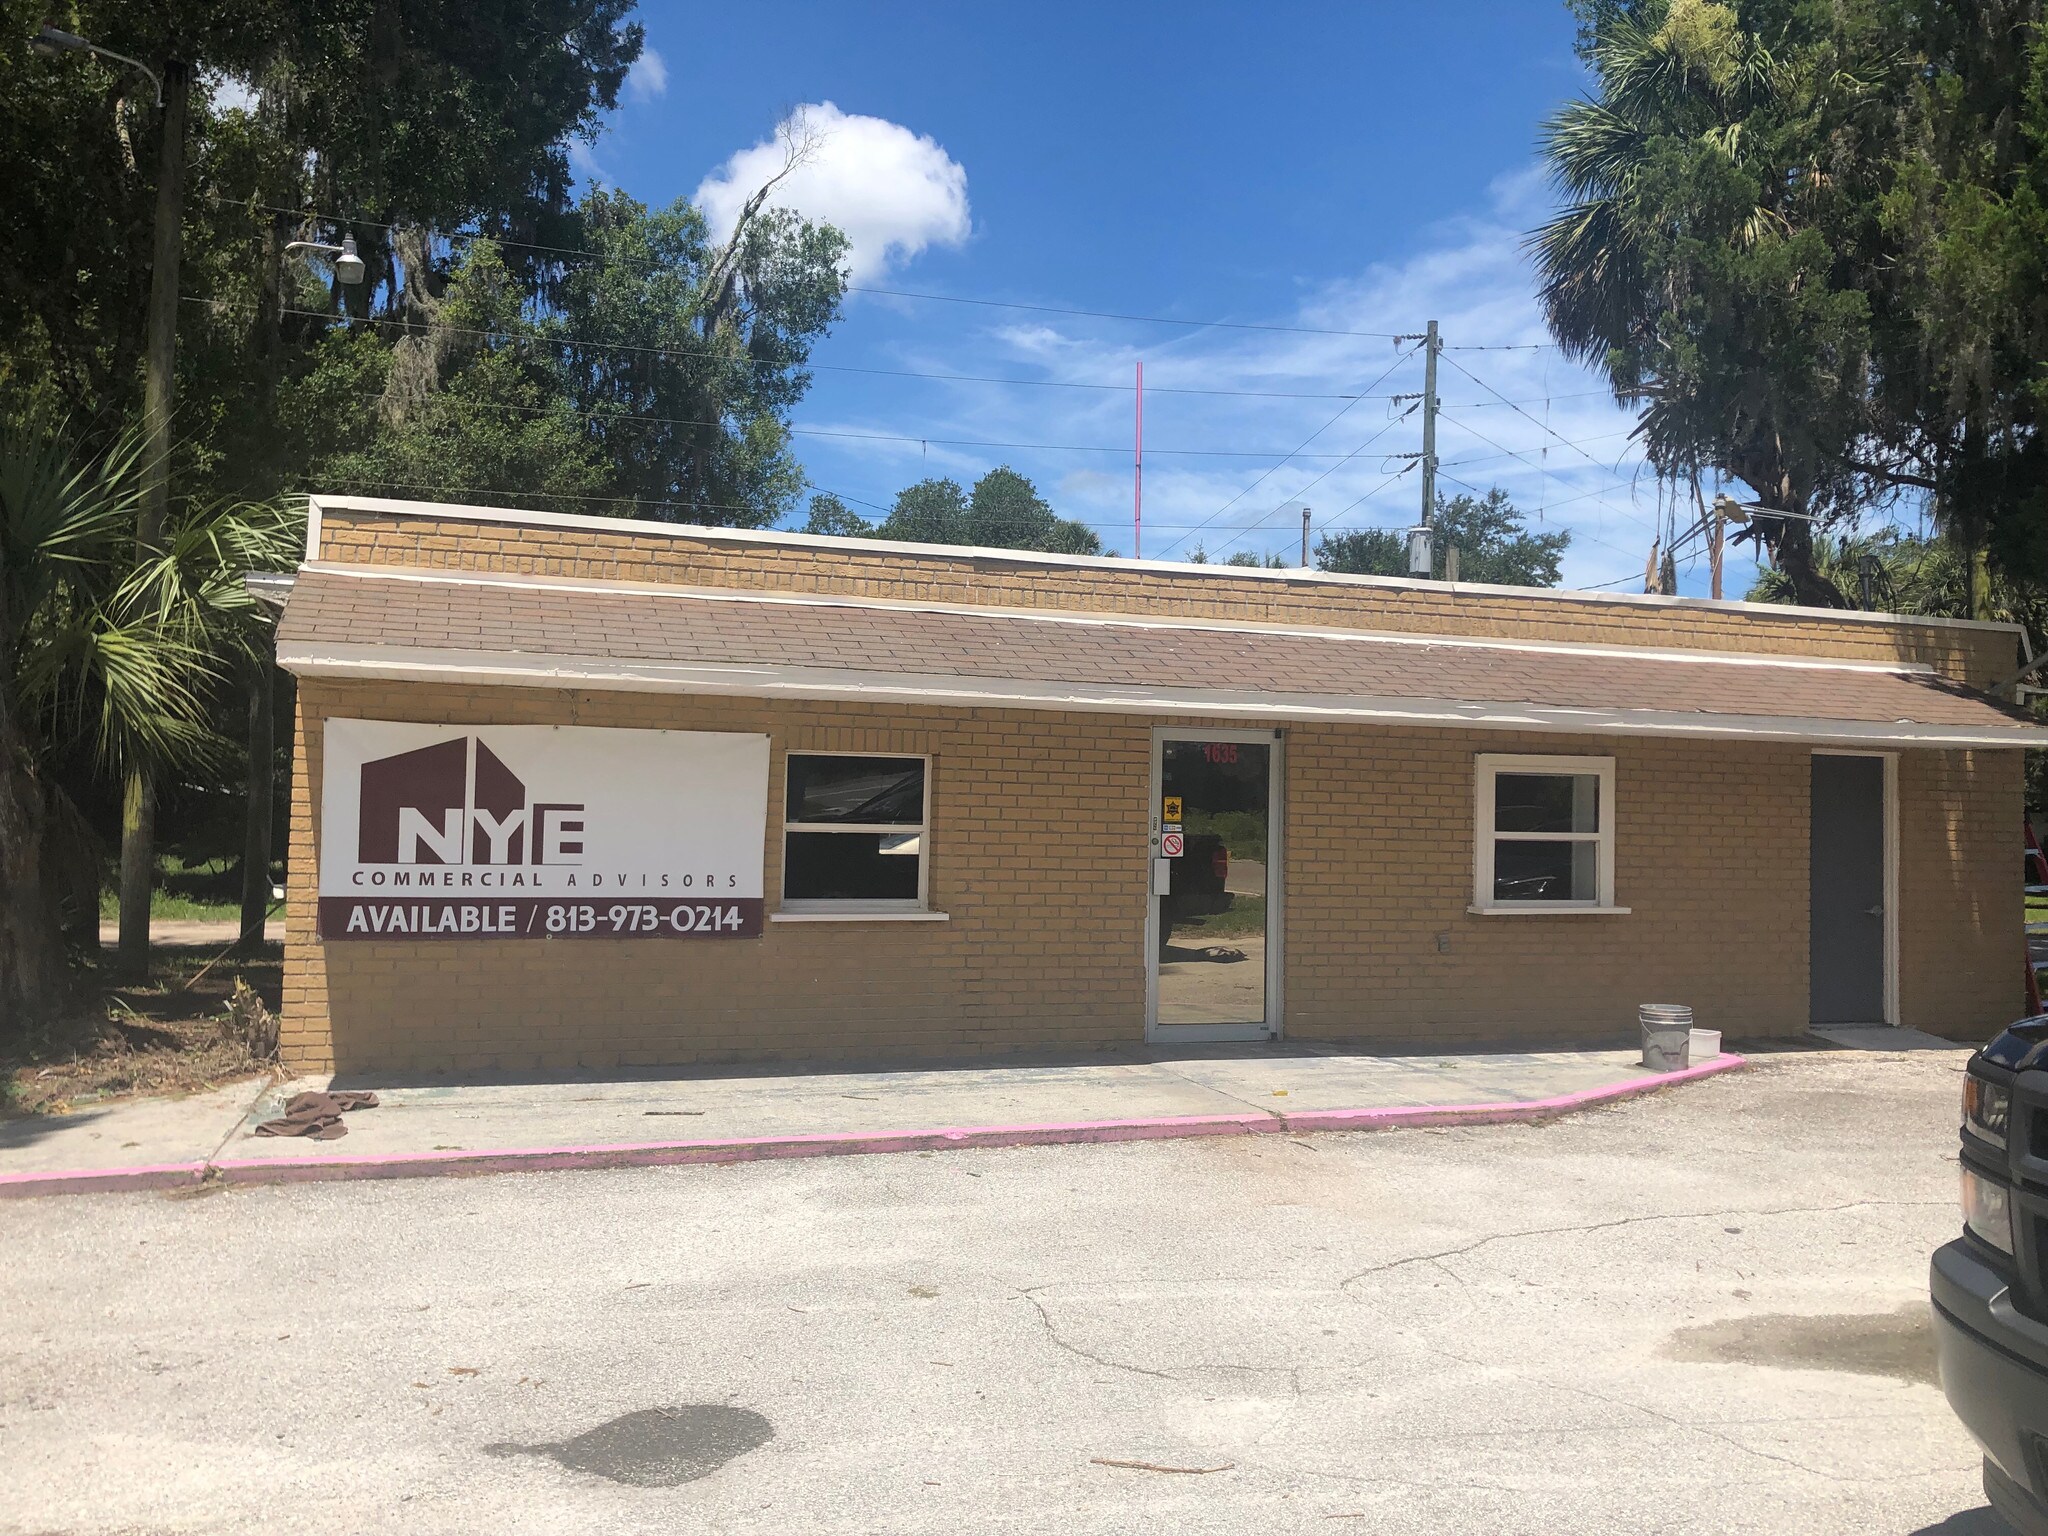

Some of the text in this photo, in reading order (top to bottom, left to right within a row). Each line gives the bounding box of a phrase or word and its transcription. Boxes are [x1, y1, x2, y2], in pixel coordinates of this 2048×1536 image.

[1203, 743, 1238, 763] 1635
[397, 805, 584, 865] NYE
[352, 871, 737, 888] COMMERCIAL ADVISORS
[346, 904, 744, 933] AVAILABLE / 813-973-0214
